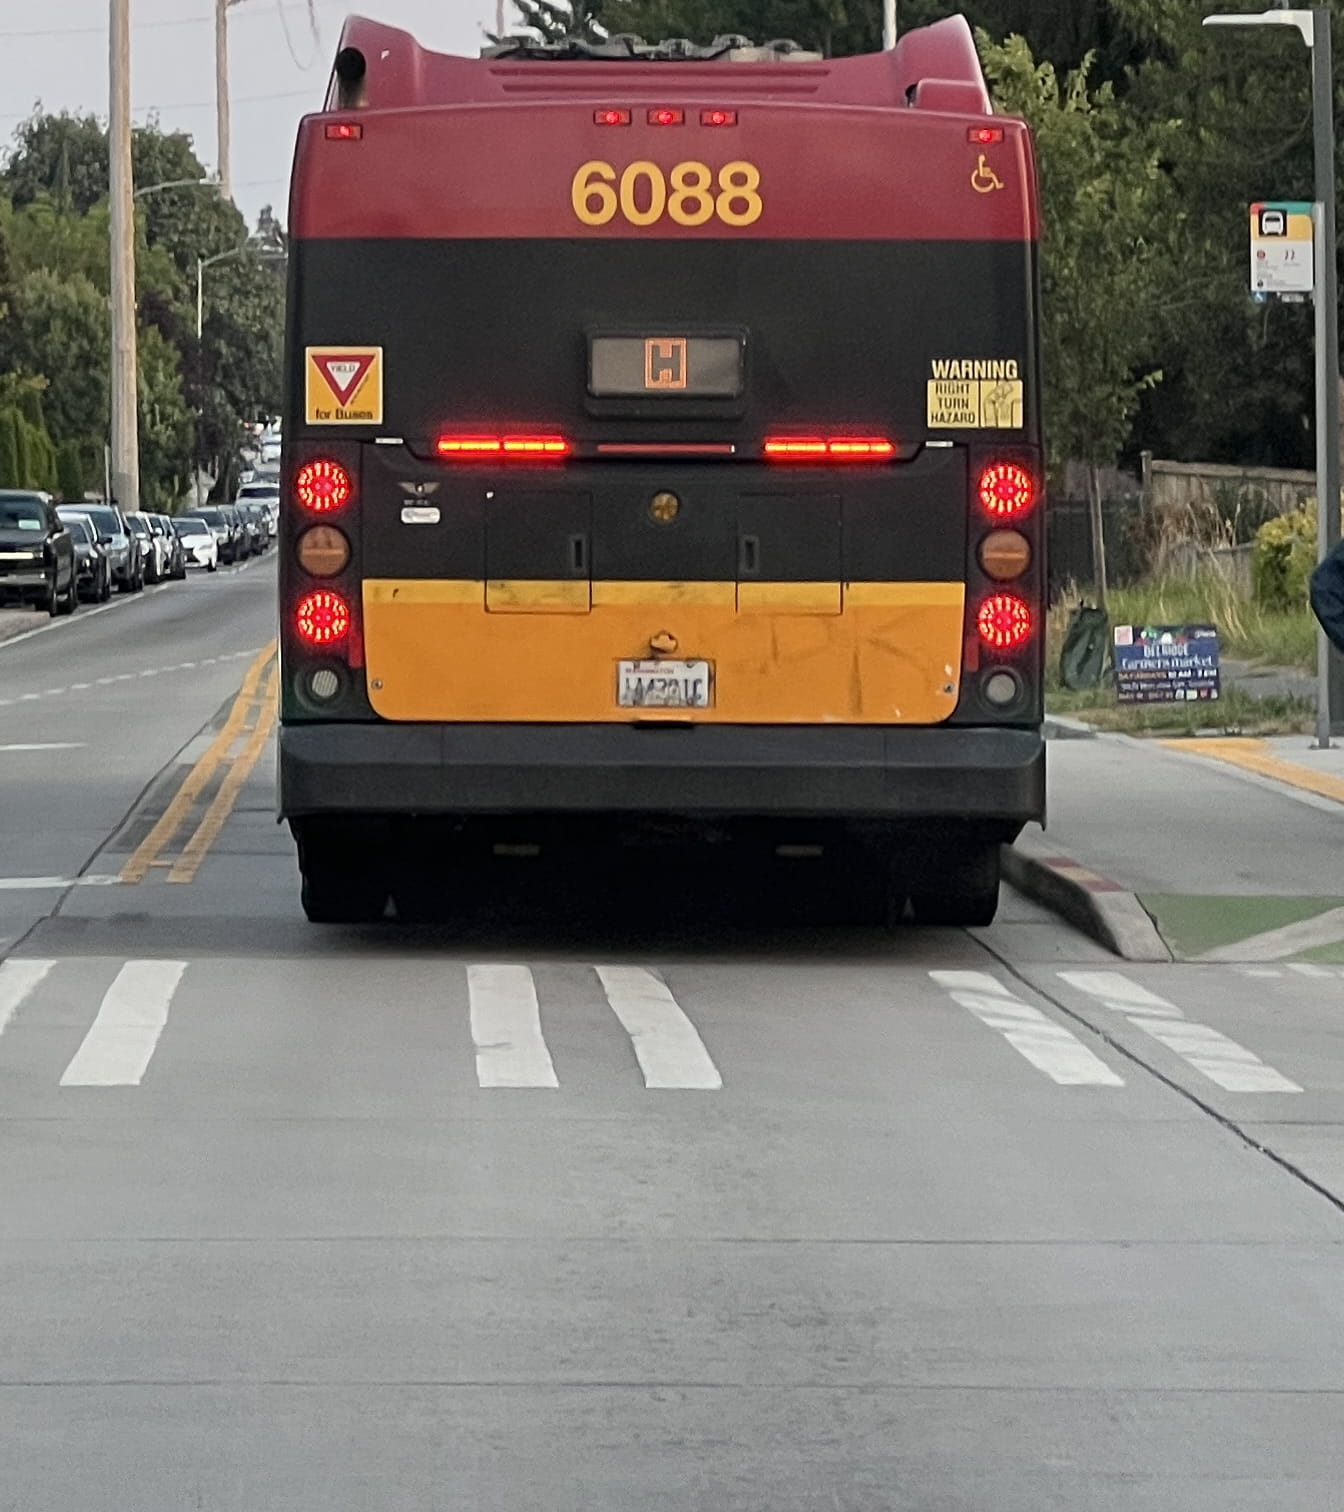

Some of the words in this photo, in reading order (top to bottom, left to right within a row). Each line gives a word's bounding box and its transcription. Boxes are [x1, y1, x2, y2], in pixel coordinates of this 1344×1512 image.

[571, 160, 763, 226] 6088
[331, 364, 356, 373] YIELD
[648, 341, 683, 385] H
[931, 359, 1018, 379] WARNING
[935, 383, 970, 395] RIGHT
[938, 397, 969, 410] TURN
[316, 408, 331, 420] for
[335, 408, 374, 420] Buses
[931, 411, 976, 424] HAZARD
